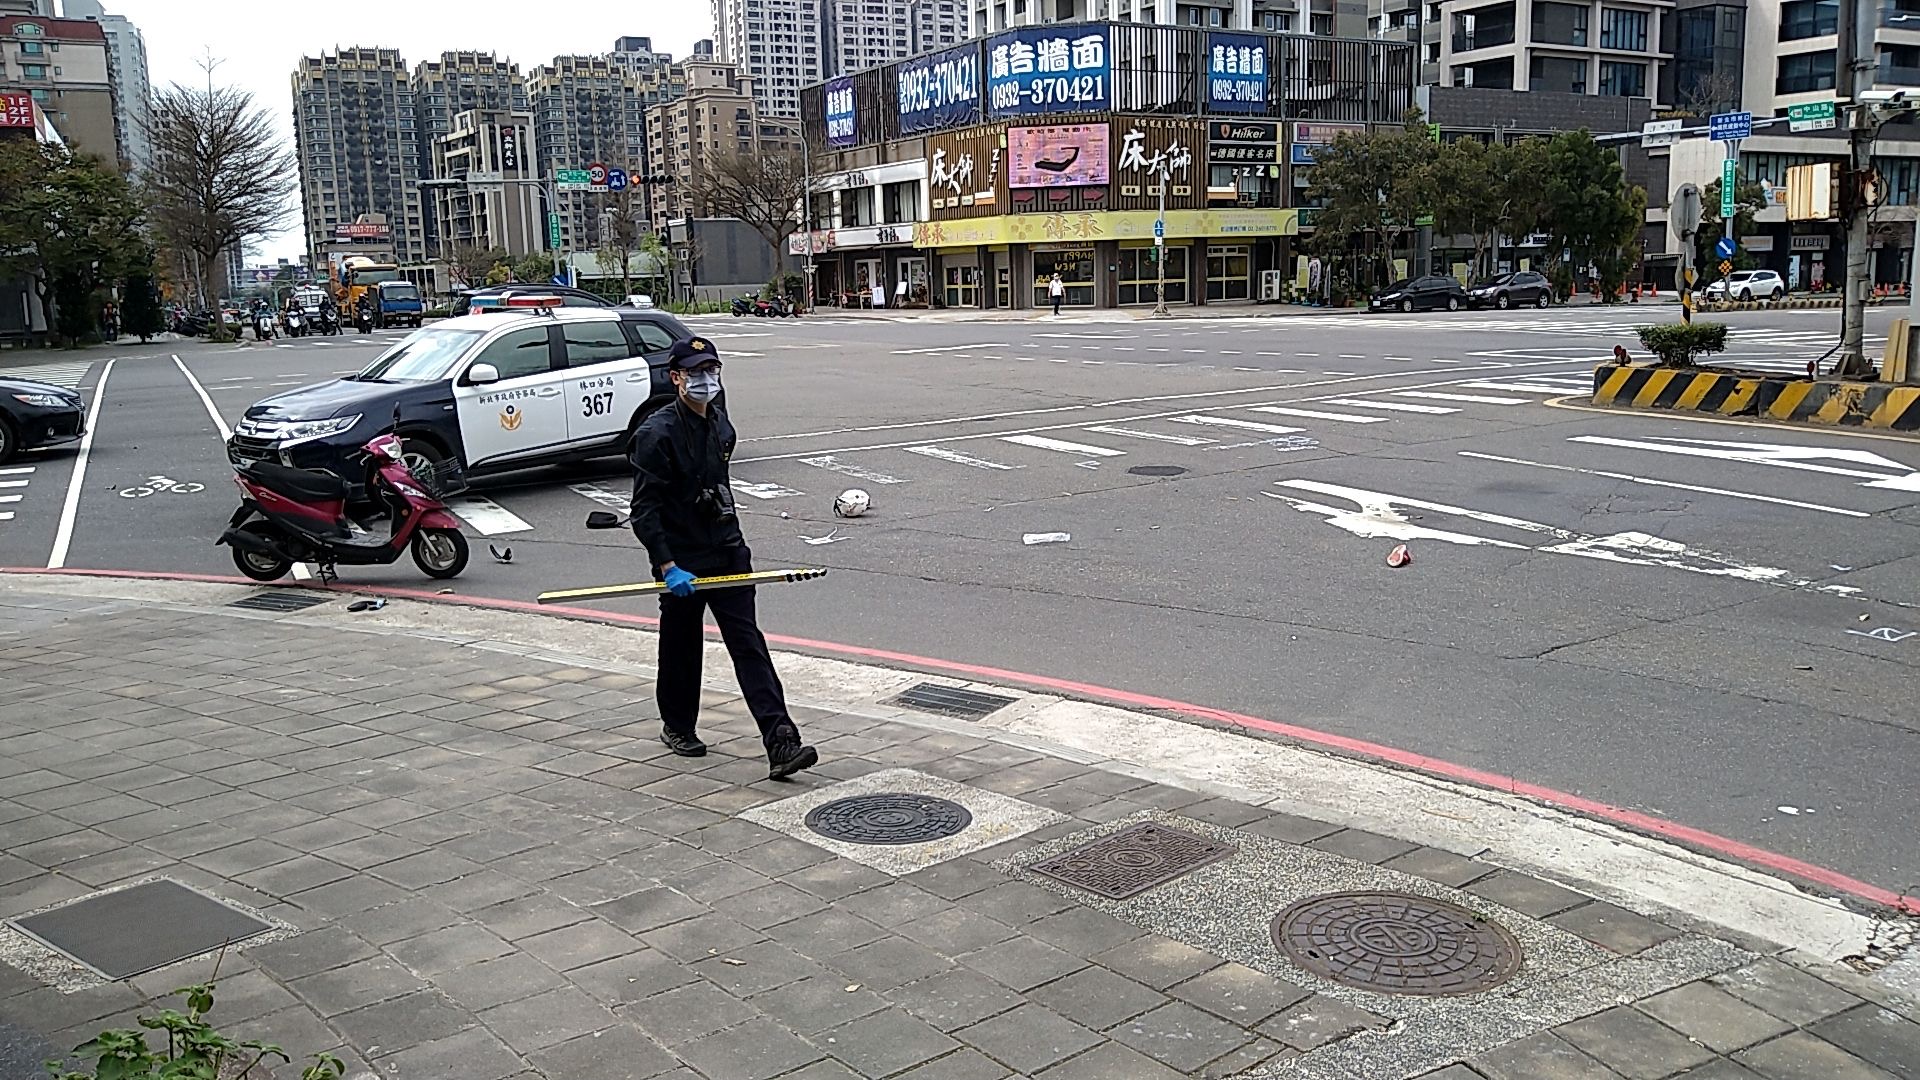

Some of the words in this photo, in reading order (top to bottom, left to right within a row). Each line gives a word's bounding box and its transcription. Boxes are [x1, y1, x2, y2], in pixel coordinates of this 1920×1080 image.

[991, 34, 1104, 79] 廣告牆面
[8, 97, 28, 106] 1F
[992, 75, 1104, 110] 0932-370421
[1212, 79, 1264, 102] 0932-370421
[8, 106, 29, 115] 2F
[9, 116, 31, 125] 7F
[1118, 128, 1192, 182] 床大師
[591, 170, 603, 178] 50
[930, 147, 974, 195] 床大師
[1042, 213, 1104, 239] 傳承
[579, 376, 614, 392] 林口分局
[479, 389, 536, 405] 新北市政府警察局
[582, 392, 614, 418] 367
